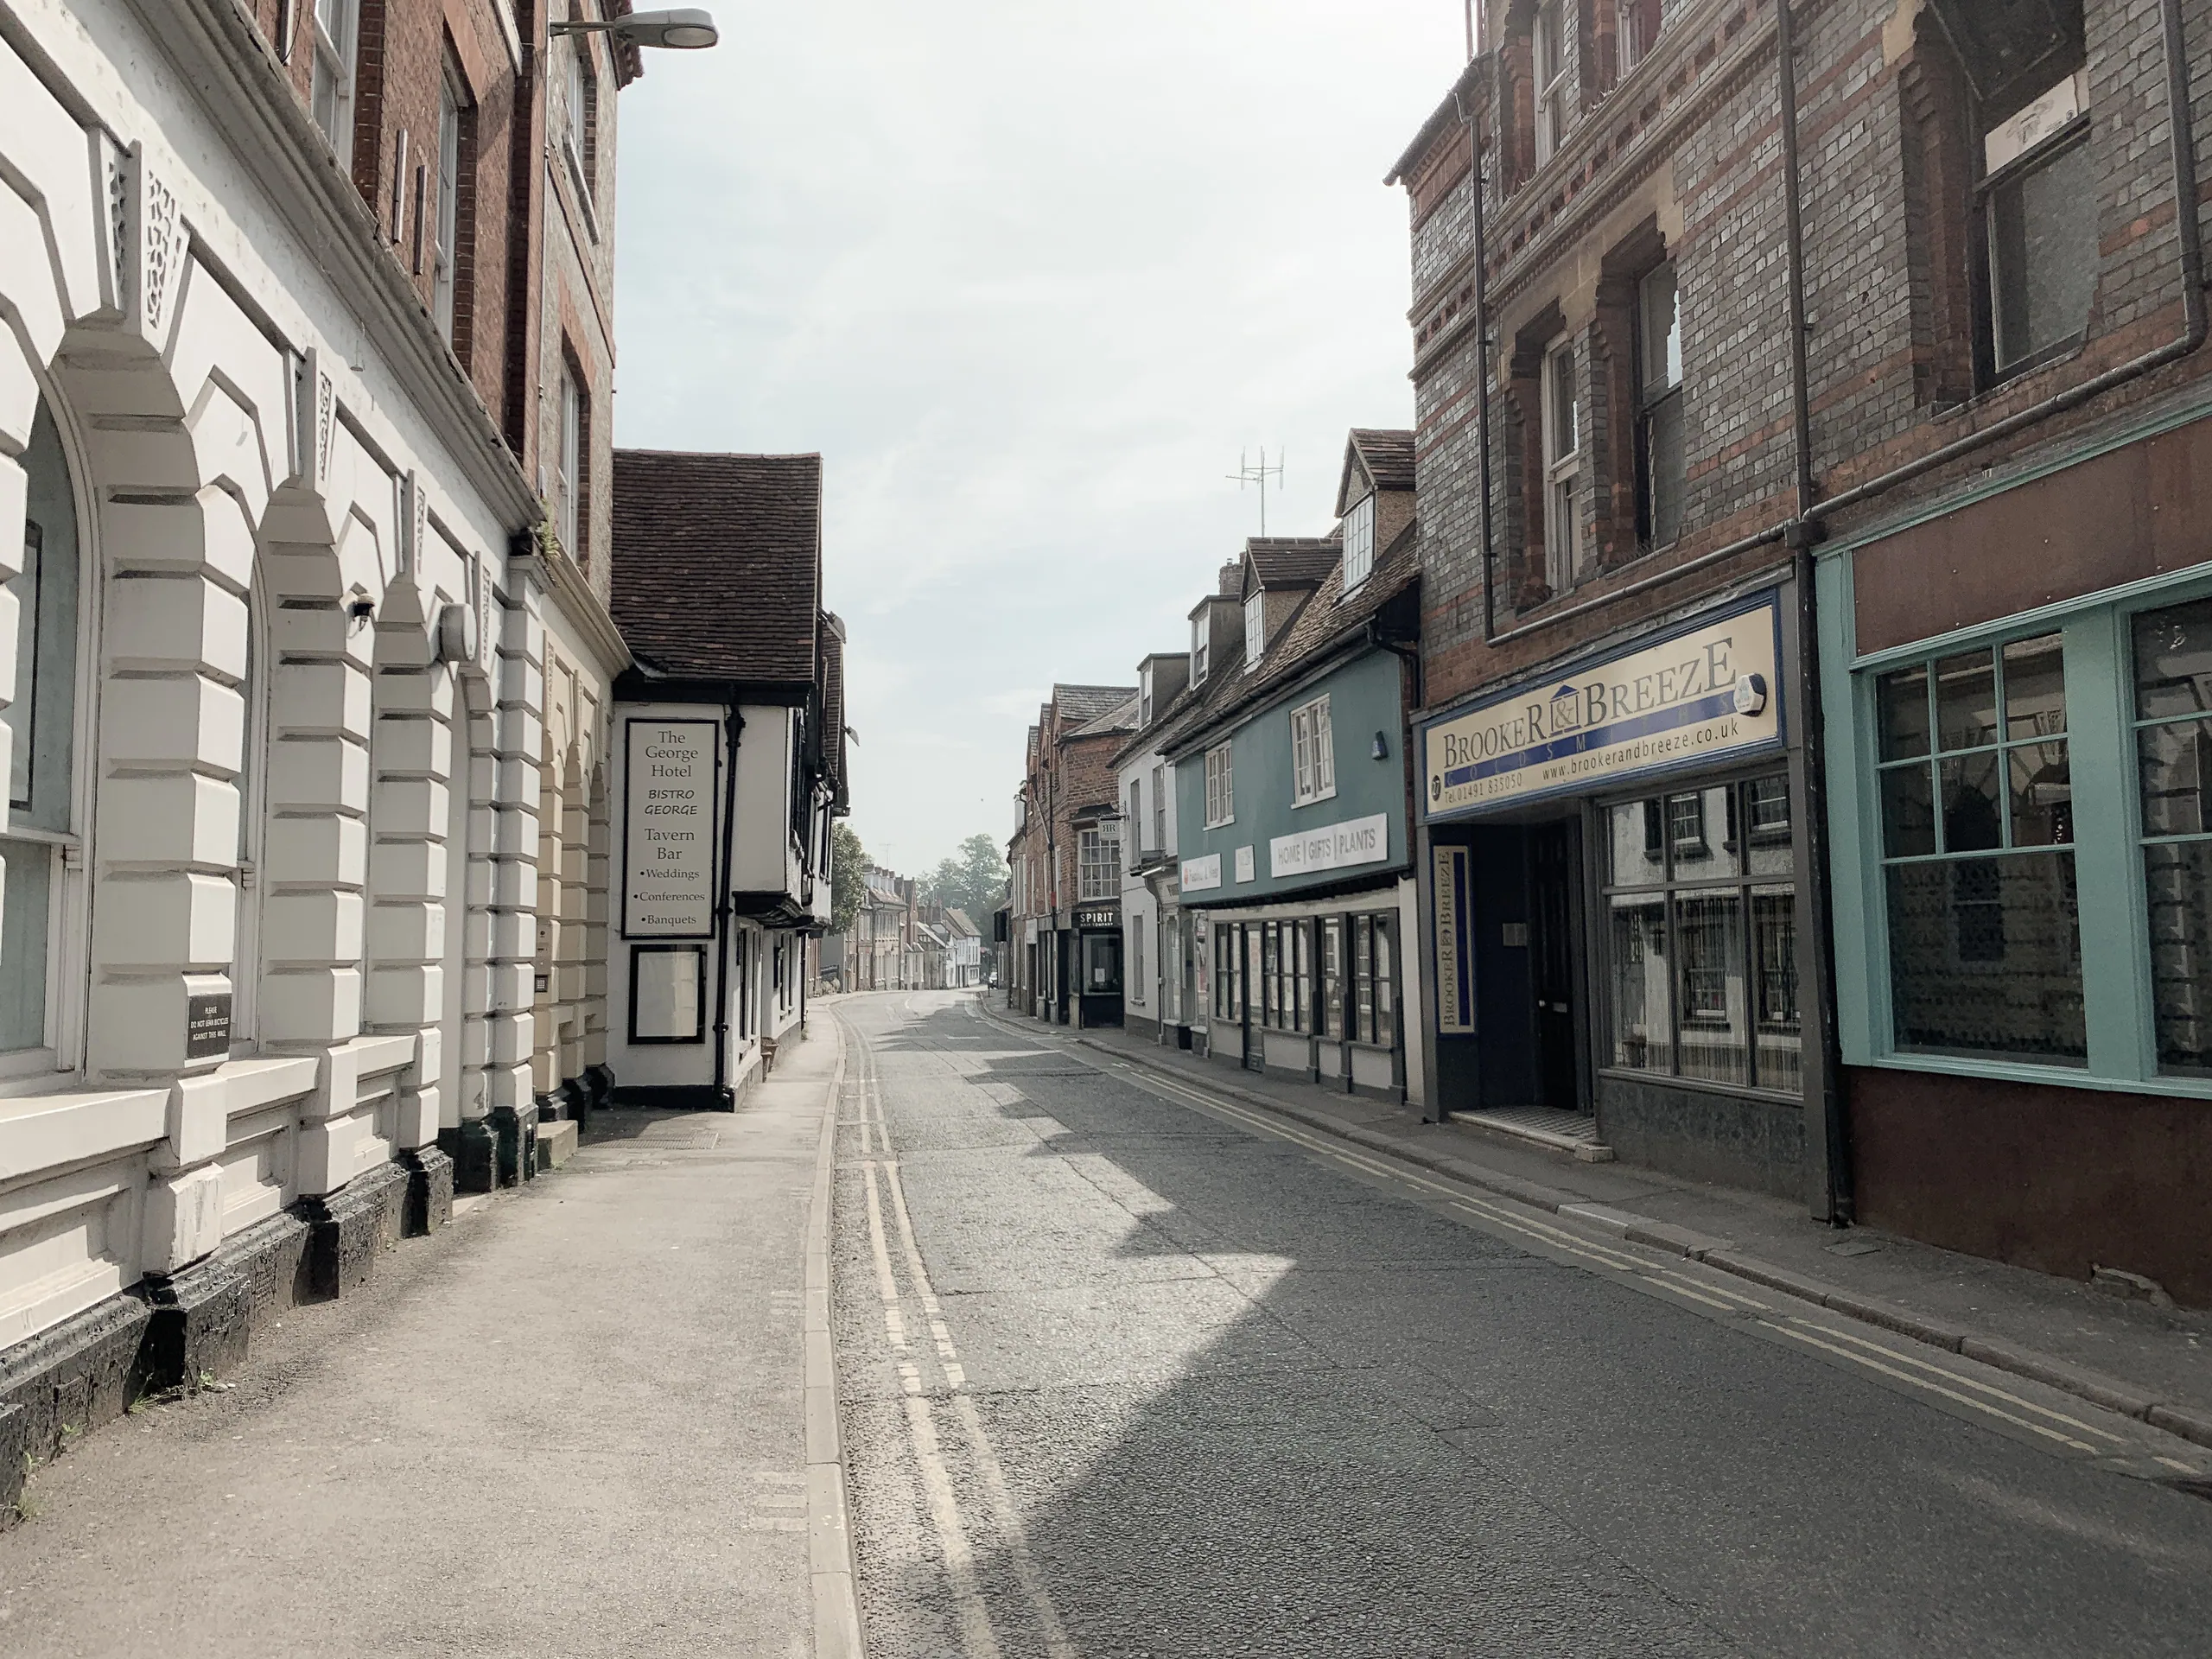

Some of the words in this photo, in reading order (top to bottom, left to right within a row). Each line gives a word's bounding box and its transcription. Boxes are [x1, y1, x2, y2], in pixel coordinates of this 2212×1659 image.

[1444, 704, 1547, 769] BROOKER
[1555, 700, 1574, 728] &
[1583, 638, 1737, 728] BREEZE
[658, 730, 686, 744] The
[645, 746, 699, 763] George
[1542, 717, 1739, 781] www.brookerandbreeze.co.uk
[651, 764, 692, 778] Hotel
[1487, 772, 1522, 794] 835050
[648, 789, 695, 799] BISTRO
[645, 804, 698, 816] GEORGE
[644, 828, 695, 842] Tavern
[1278, 844, 1300, 865] HOME
[1308, 838, 1332, 859] GIFTS
[1339, 828, 1376, 853] PLANTS
[657, 847, 683, 861] Bar
[645, 868, 700, 881] Weddings
[1438, 851, 1452, 926] BREEZE
[639, 891, 705, 902] Conferences
[647, 914, 696, 927] Banquets
[1080, 912, 1114, 923] SPIRIT
[1441, 950, 1455, 1027] BROOKER
[205, 1006, 218, 1014] PLEASE
[190, 1020, 197, 1029] DO
[205, 1019, 213, 1027] LEAN
[214, 1017, 229, 1026] BICYCLES
[193, 1032, 208, 1041] AGAINST
